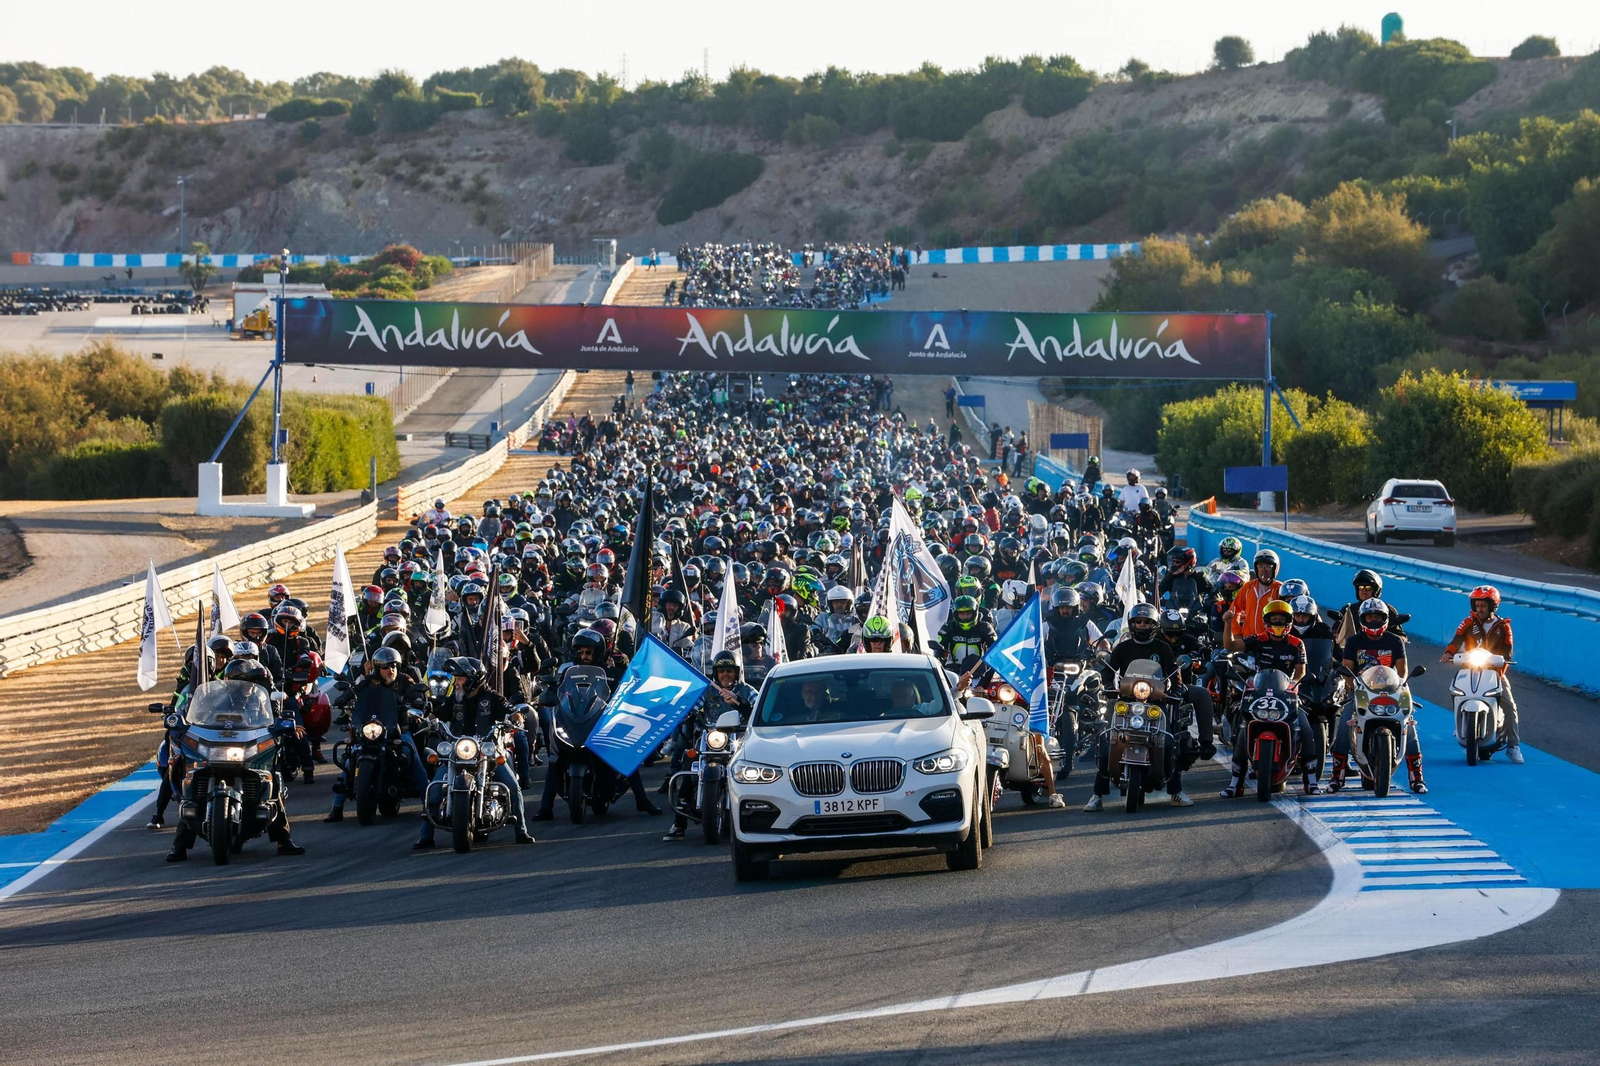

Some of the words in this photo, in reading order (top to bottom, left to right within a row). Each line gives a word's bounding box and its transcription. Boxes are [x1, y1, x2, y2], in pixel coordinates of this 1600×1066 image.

[346, 305, 543, 355] Andalucía
[676, 312, 872, 360] Andalucía
[1005, 317, 1201, 364] Andalucía
[908, 350, 926, 358] Junta
[926, 350, 935, 358] de
[935, 350, 967, 359] Andalucía
[1257, 698, 1278, 710] 31
[824, 800, 854, 812] 3812
[857, 798, 880, 811] KPF
